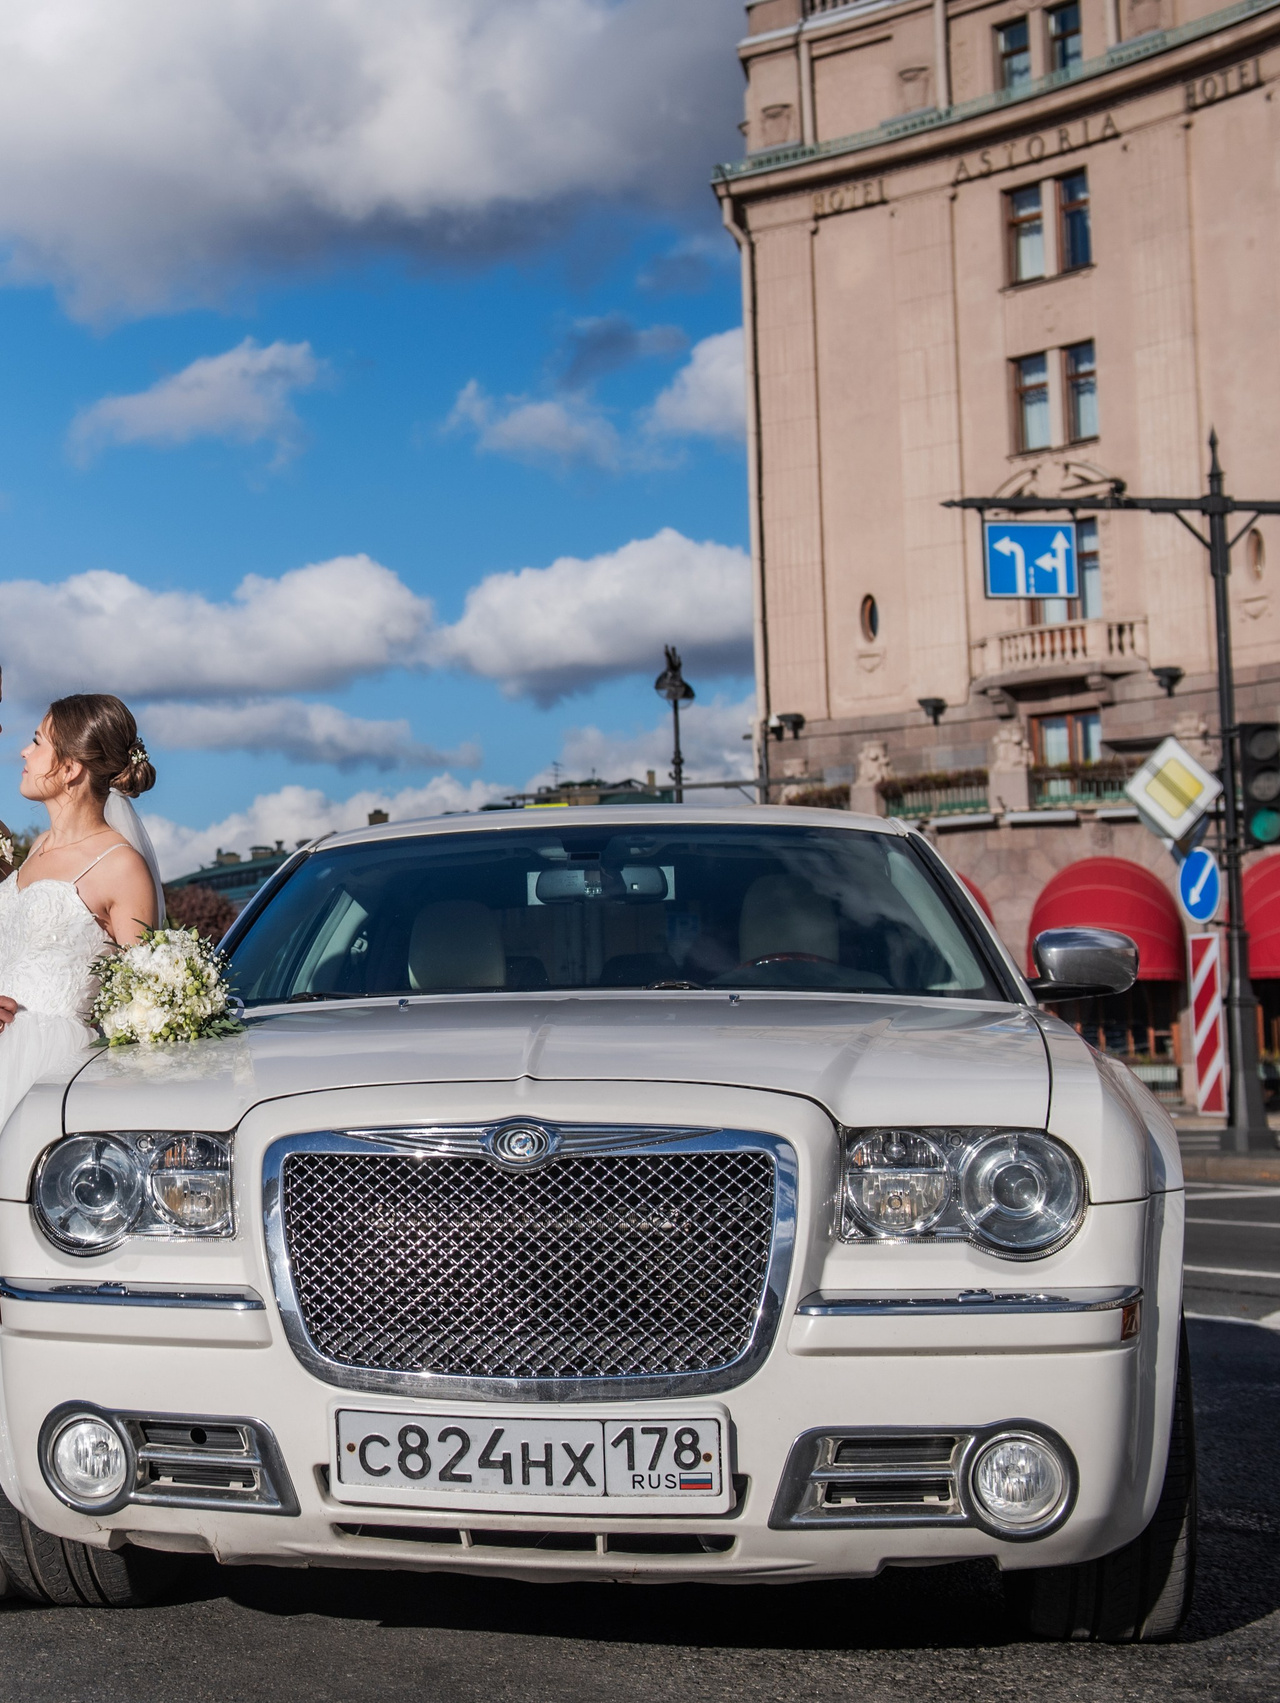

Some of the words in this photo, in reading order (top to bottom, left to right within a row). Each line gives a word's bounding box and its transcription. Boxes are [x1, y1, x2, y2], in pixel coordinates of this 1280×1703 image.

[1185, 57, 1264, 112] HOTEL
[812, 178, 888, 218] HOTEL
[952, 113, 1121, 185] ASTORIA
[610, 1426, 701, 1471] 178
[632, 1473, 677, 1489] RUS
